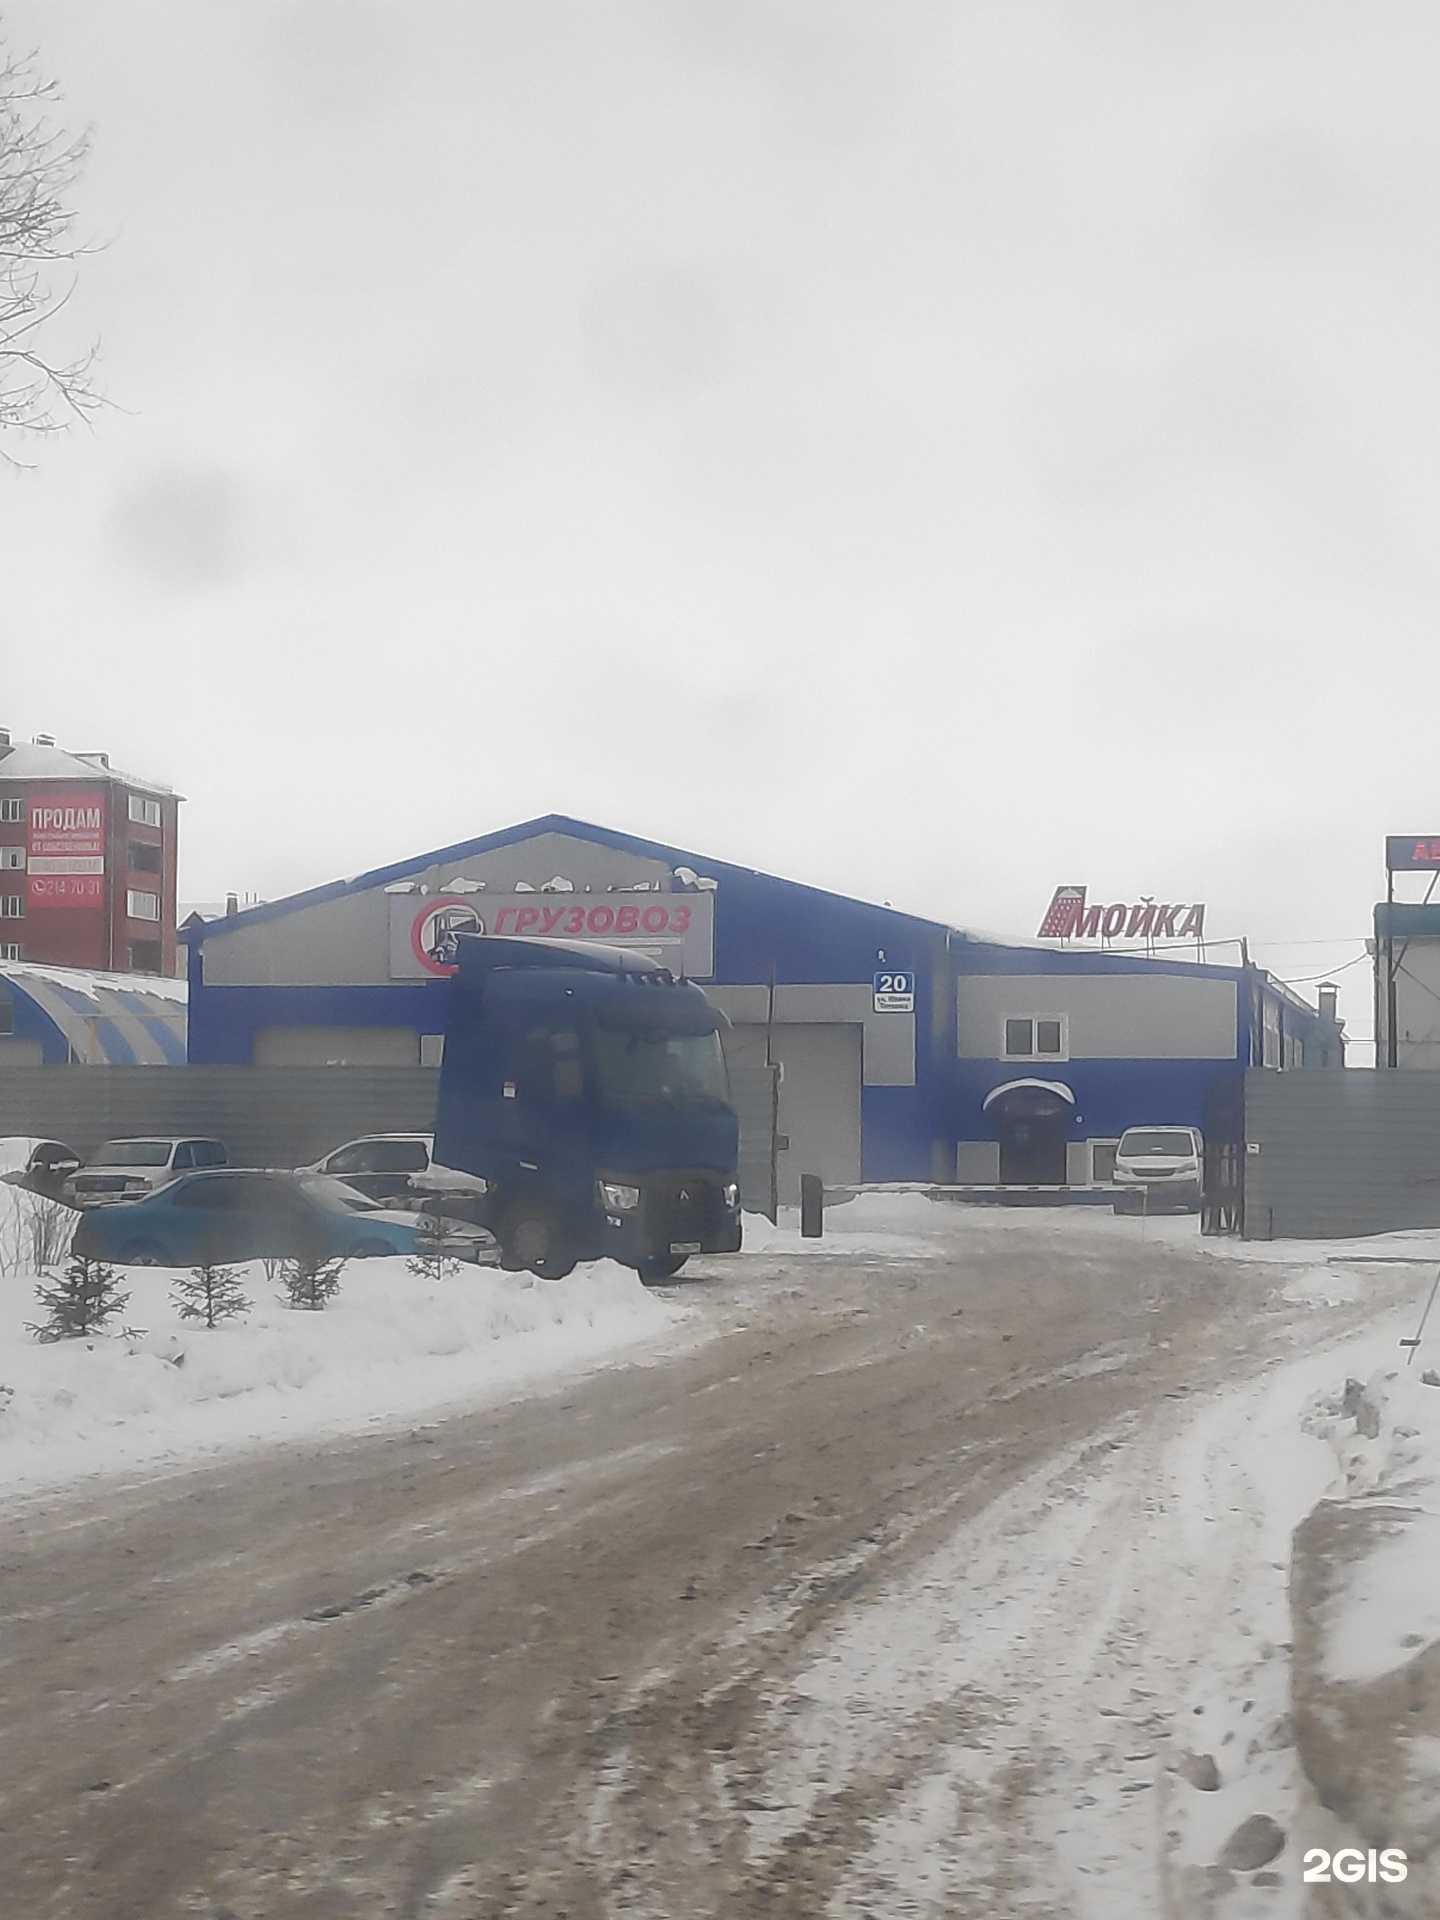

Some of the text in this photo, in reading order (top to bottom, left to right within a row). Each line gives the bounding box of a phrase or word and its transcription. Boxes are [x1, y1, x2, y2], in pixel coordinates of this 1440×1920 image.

[32, 807, 100, 831] ПРОДАМ
[494, 905, 692, 935] ГРУЗОВОЗ
[1062, 896, 1206, 938] МОЙКА
[880, 975, 907, 991] 20
